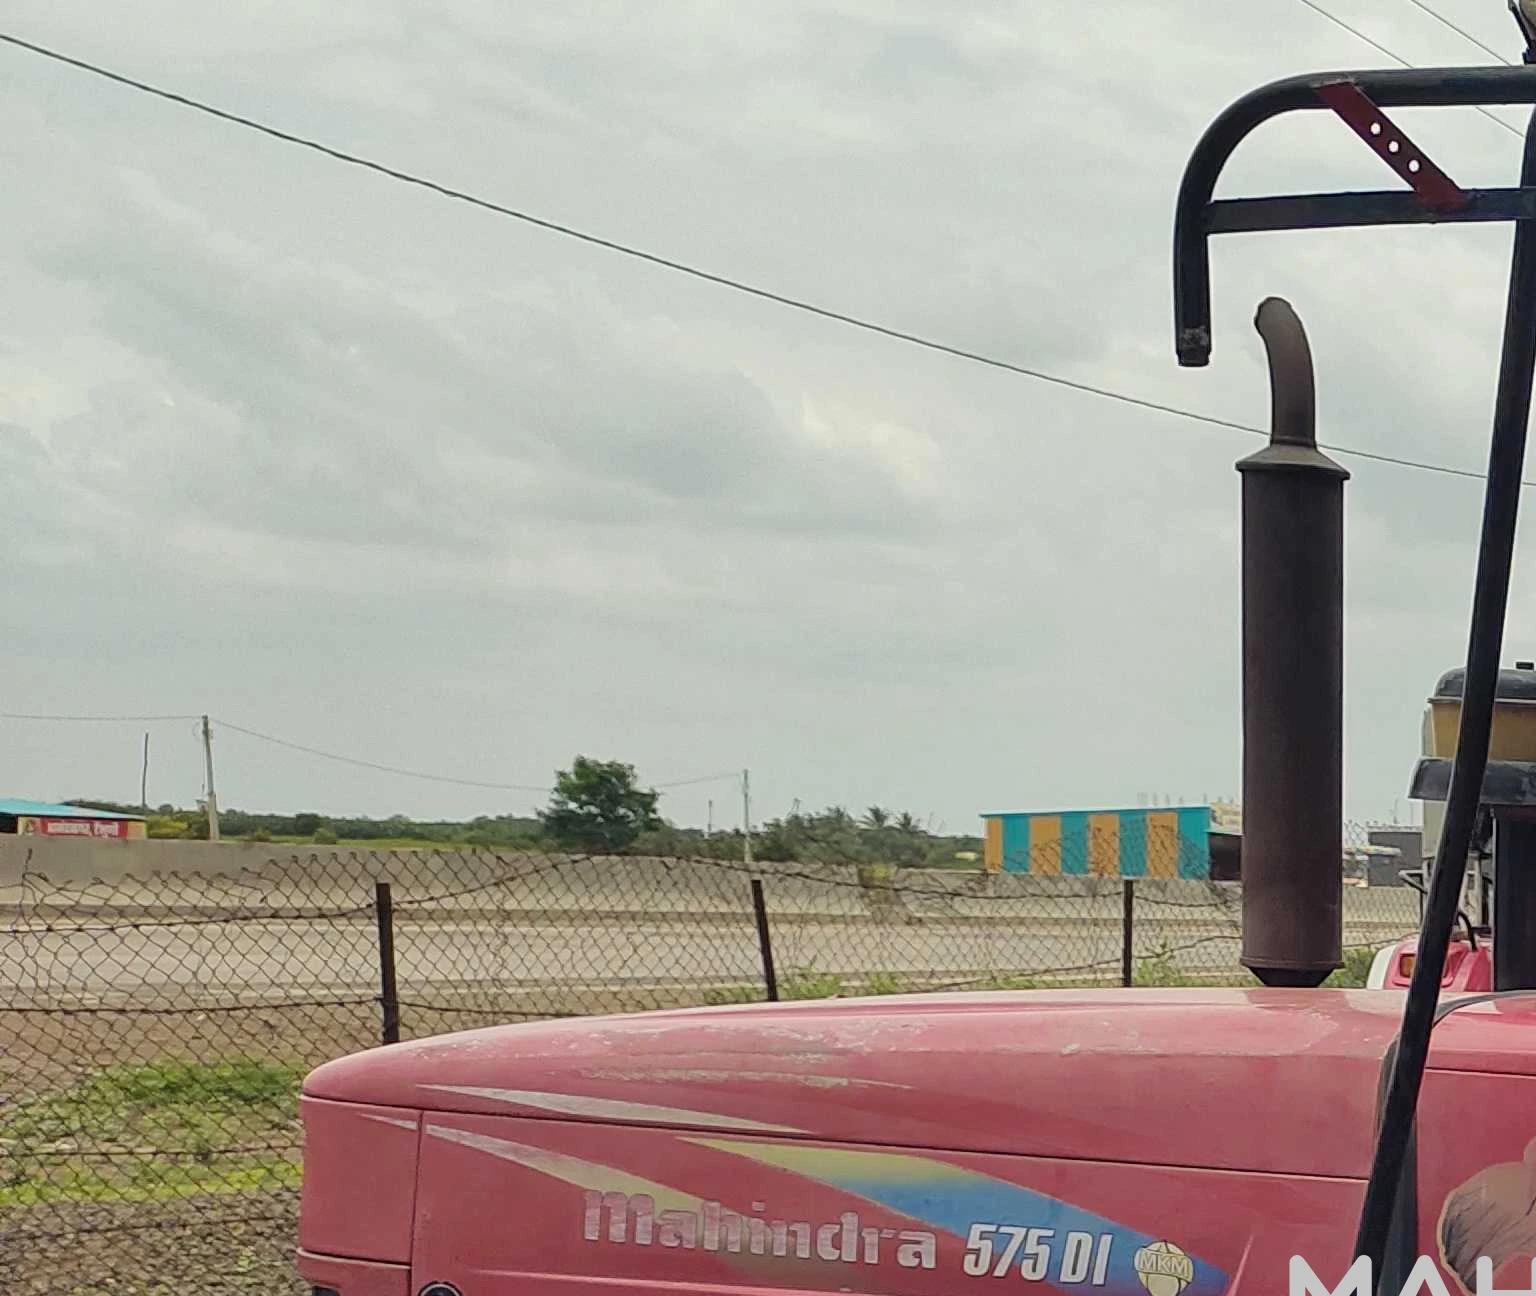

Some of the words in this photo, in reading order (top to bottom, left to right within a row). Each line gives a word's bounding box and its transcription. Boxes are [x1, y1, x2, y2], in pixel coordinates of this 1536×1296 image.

[963, 1222, 1055, 1282] 575
[1059, 1231, 1113, 1286] DI
[1137, 1250, 1191, 1280] MKM
